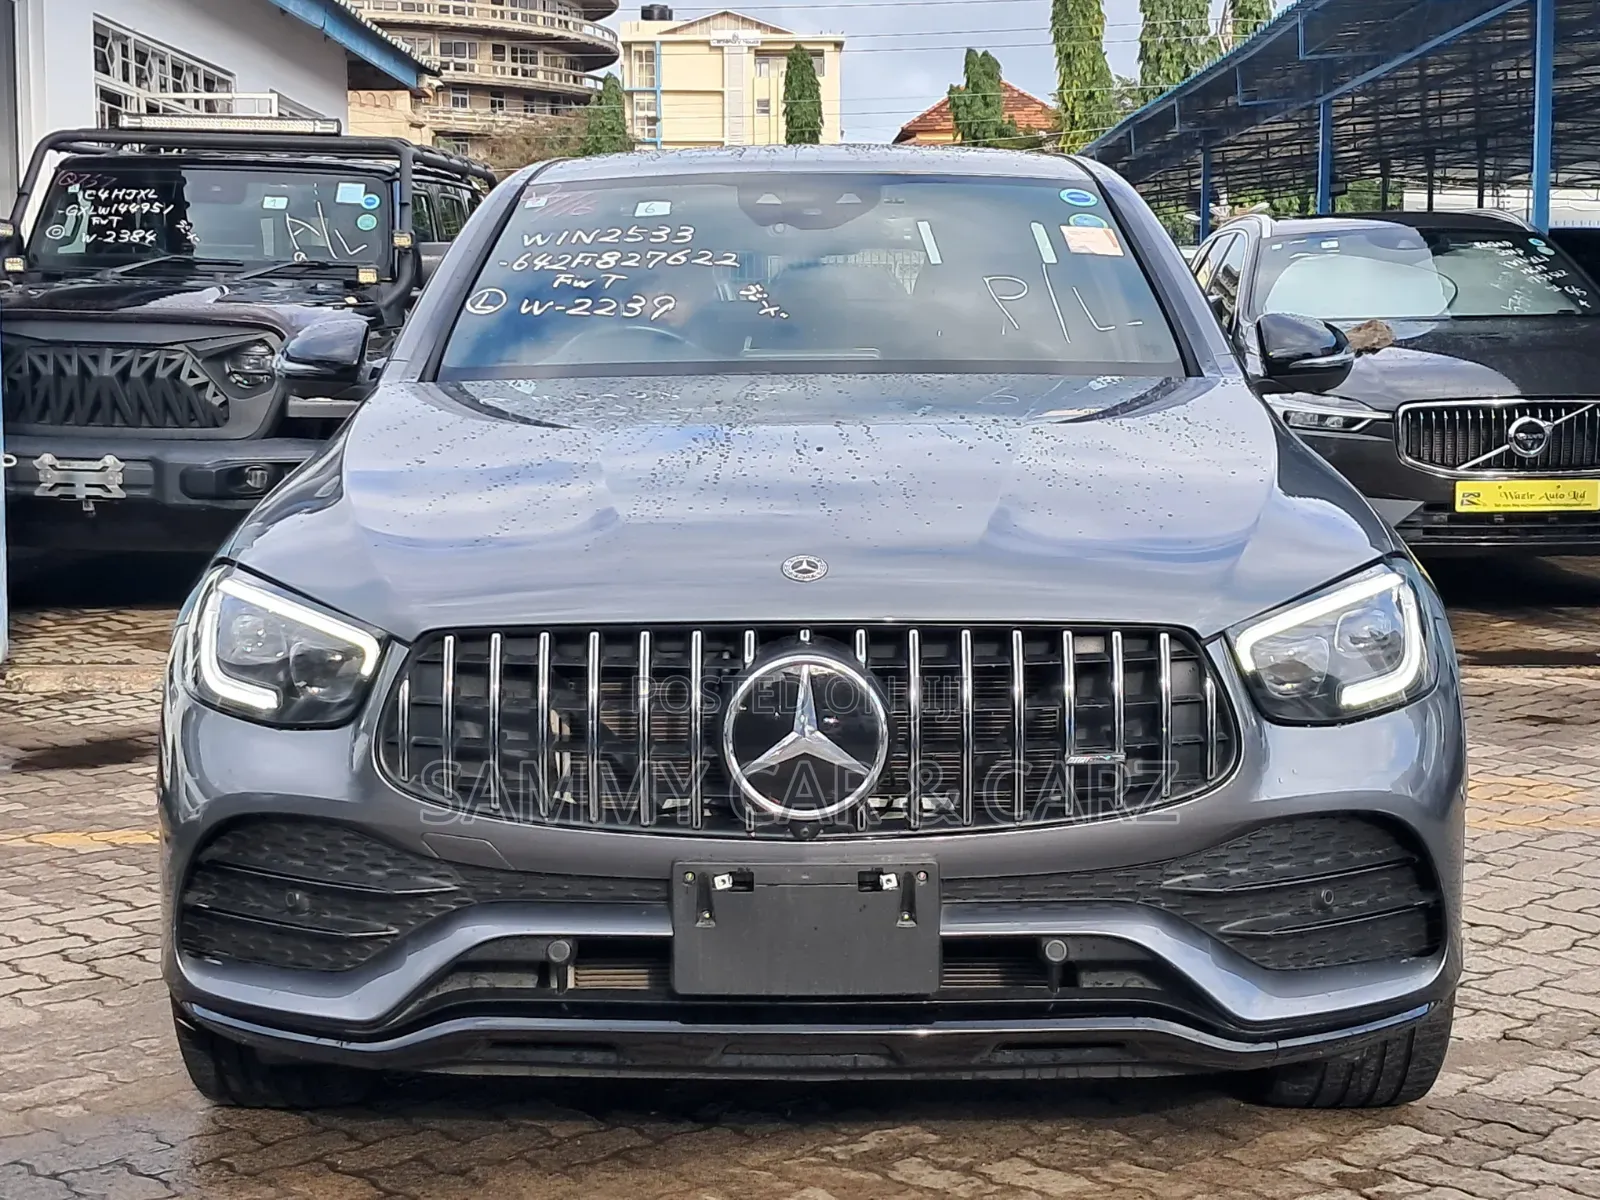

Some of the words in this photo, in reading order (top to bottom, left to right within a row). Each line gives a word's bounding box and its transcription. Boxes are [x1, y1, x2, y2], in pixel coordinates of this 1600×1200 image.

[81, 229, 157, 243] W-2384
[520, 294, 676, 321] W-2239
[1499, 491, 1535, 500] Wazir
[1538, 492, 1565, 504] Auto
[1567, 490, 1587, 502] Ltd
